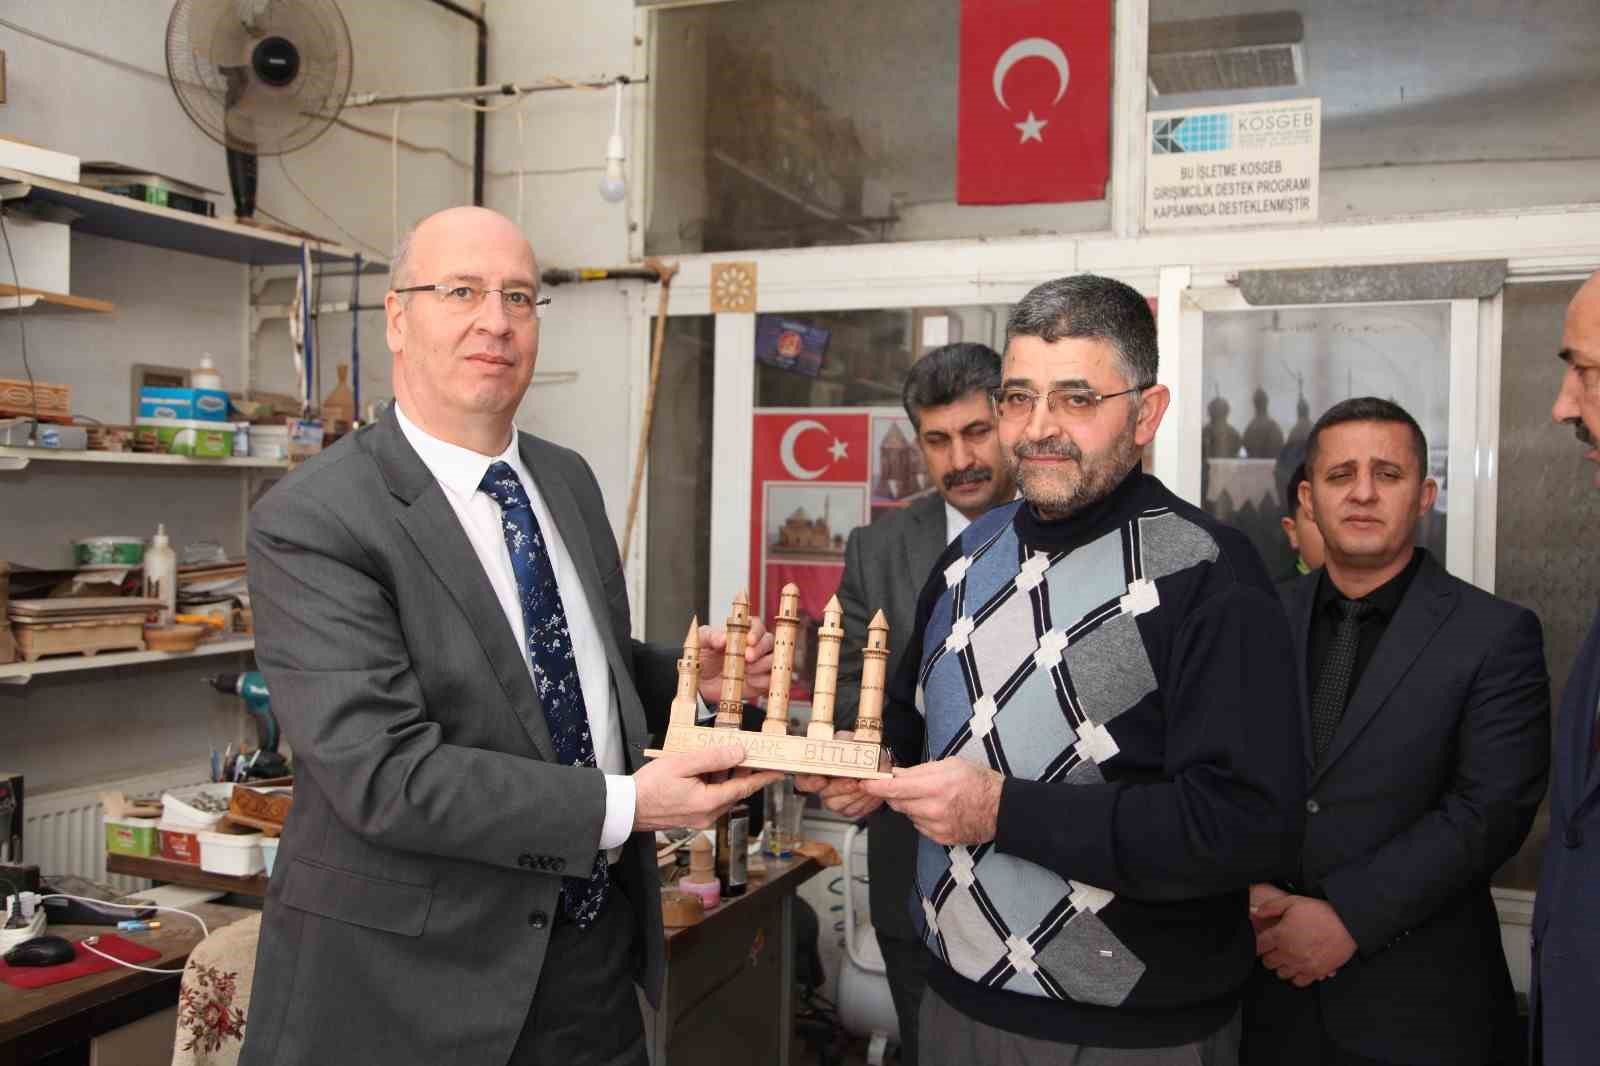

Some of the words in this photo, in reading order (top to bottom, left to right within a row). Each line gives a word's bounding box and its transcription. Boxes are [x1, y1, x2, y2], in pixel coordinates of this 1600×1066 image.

[1238, 112, 1313, 131] KOSGEB
[1180, 166, 1194, 180] BU
[1239, 159, 1282, 175] KOSGEB
[1215, 182, 1254, 197] DESTEK
